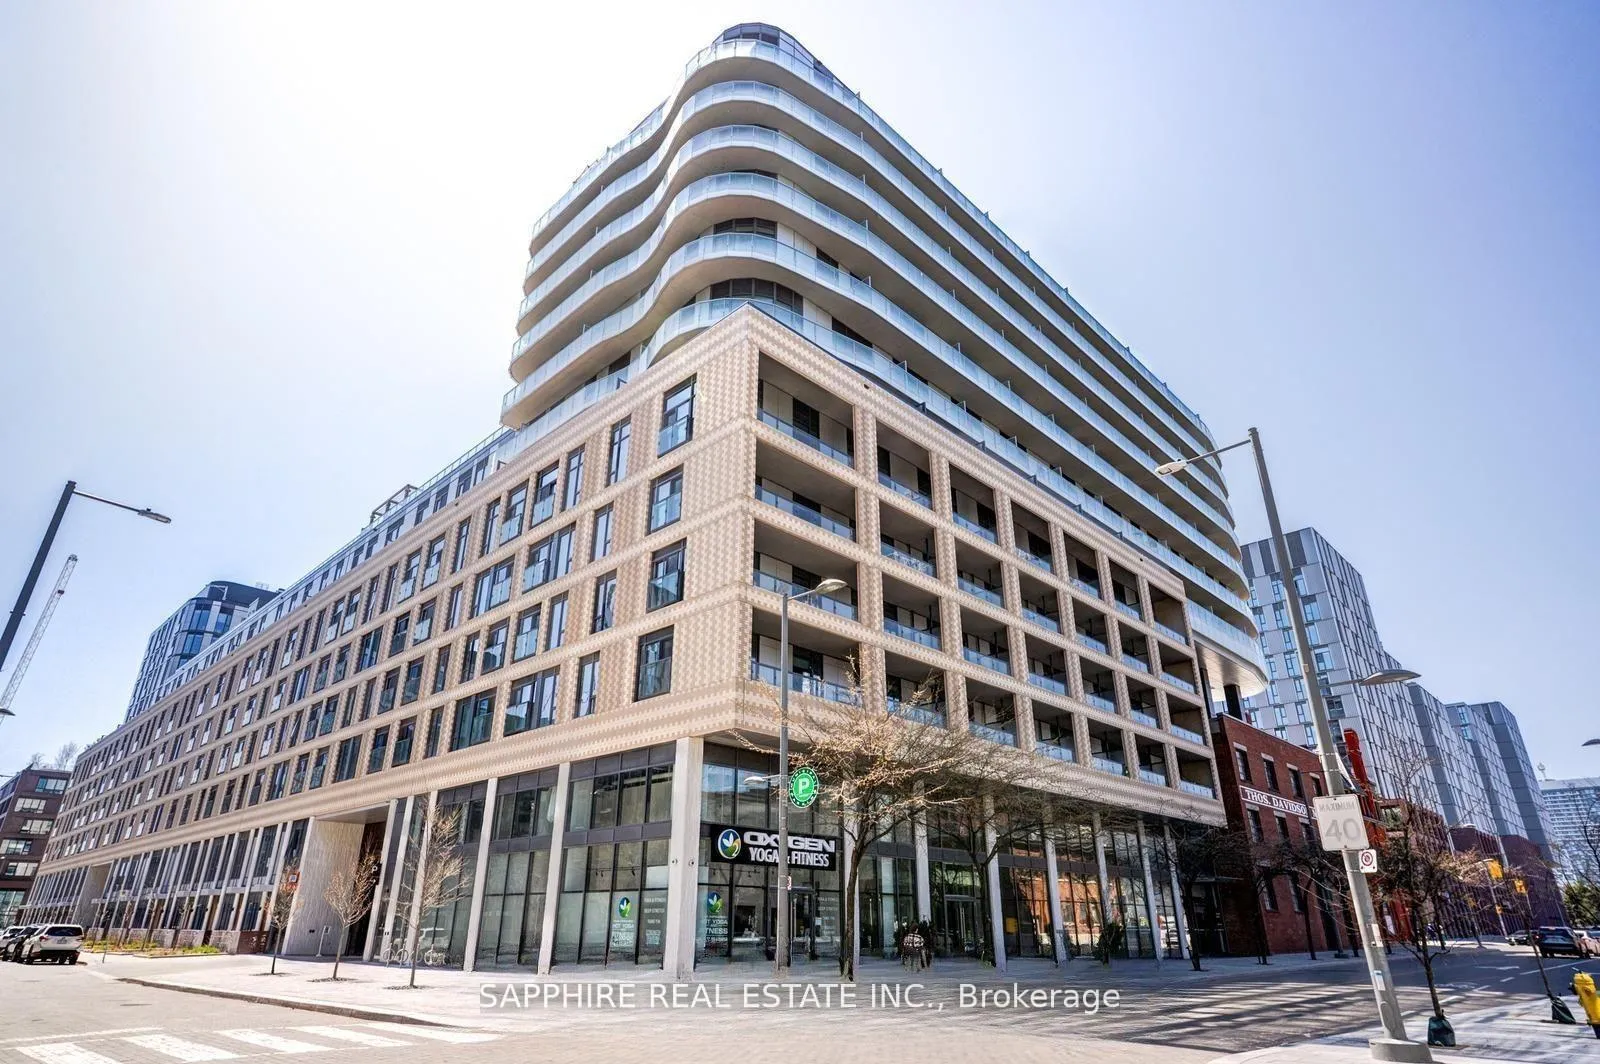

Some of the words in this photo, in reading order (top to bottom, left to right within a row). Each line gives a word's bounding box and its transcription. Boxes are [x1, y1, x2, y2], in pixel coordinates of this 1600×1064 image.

[798, 778, 809, 794] P
[1245, 789, 1271, 805] THOS.
[1272, 798, 1309, 815] DAVIDSO
[1319, 801, 1356, 812] MAXIMUM
[1325, 818, 1361, 841] 40
[749, 847, 779, 863] YOGA
[791, 850, 830, 867] FITNESS
